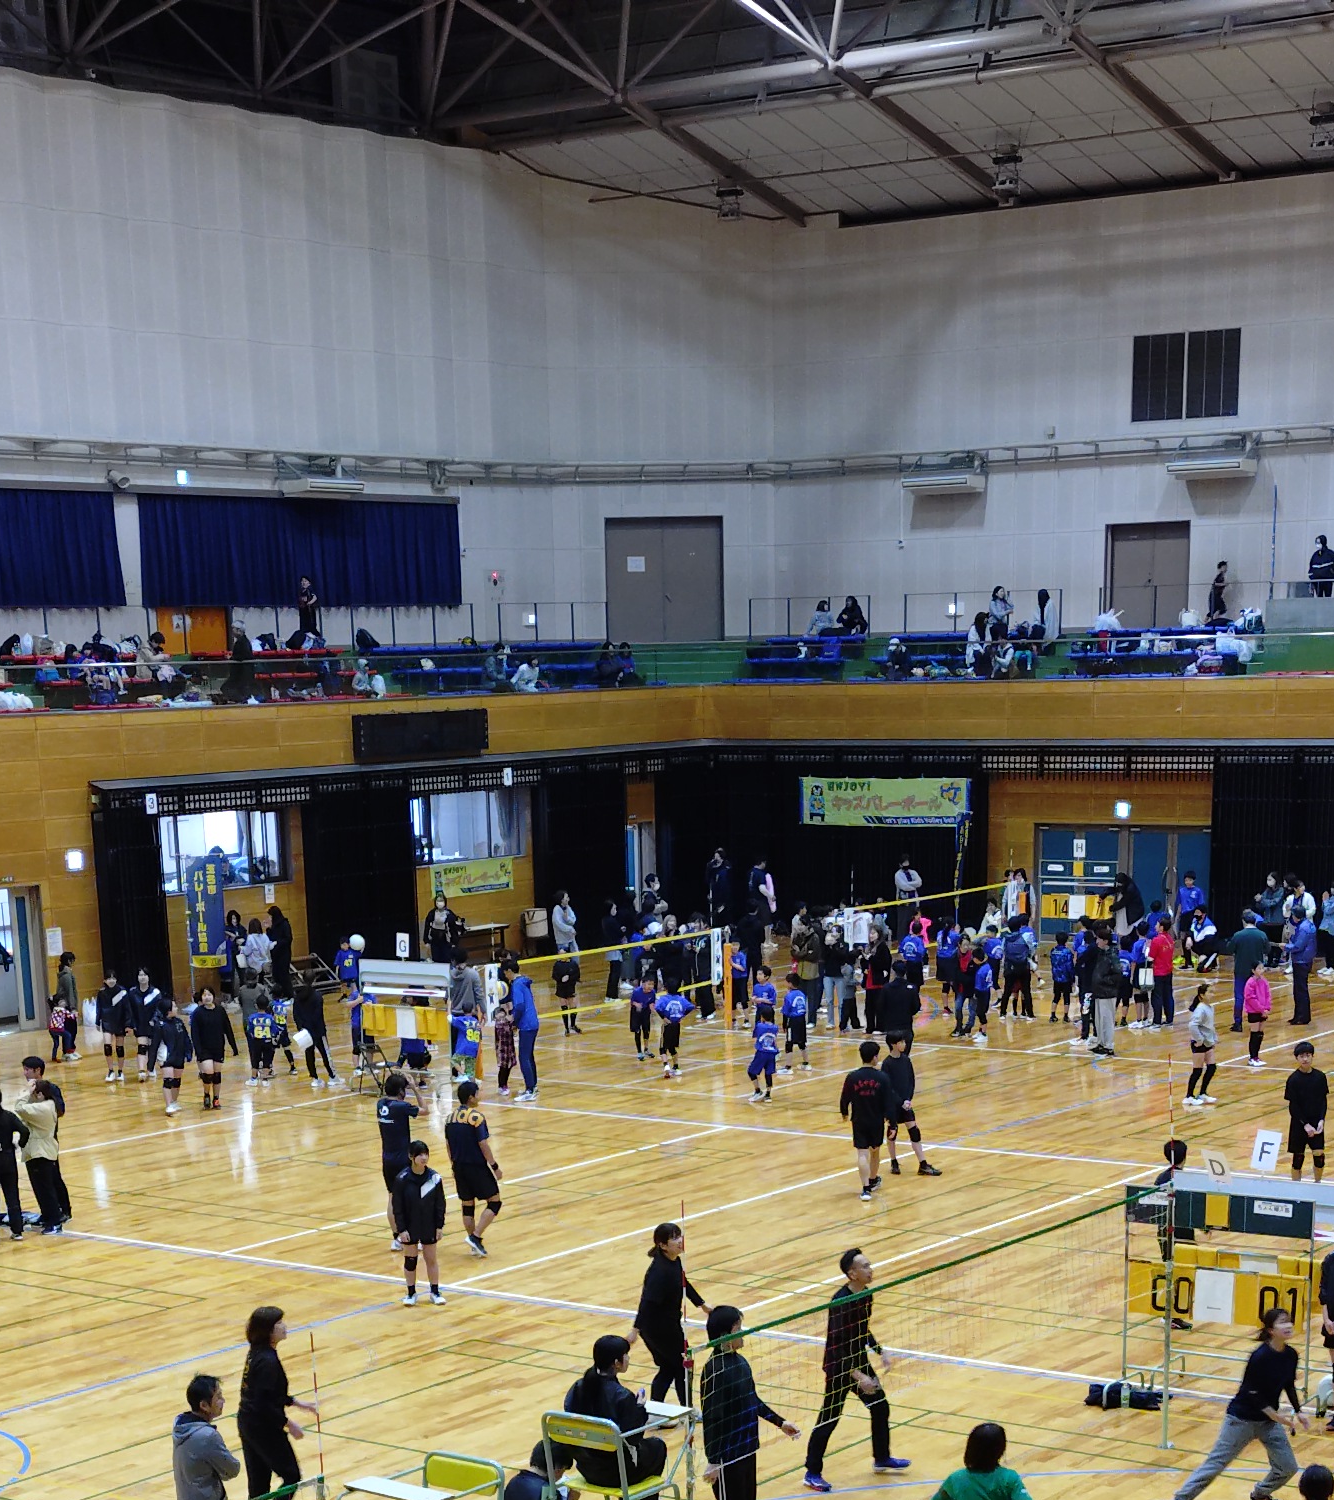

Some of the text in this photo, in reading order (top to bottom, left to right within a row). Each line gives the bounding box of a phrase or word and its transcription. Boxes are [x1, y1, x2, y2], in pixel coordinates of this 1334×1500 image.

[398, 939, 407, 953] G
[1258, 1141, 1275, 1162] F
[1208, 1158, 1226, 1177] D
